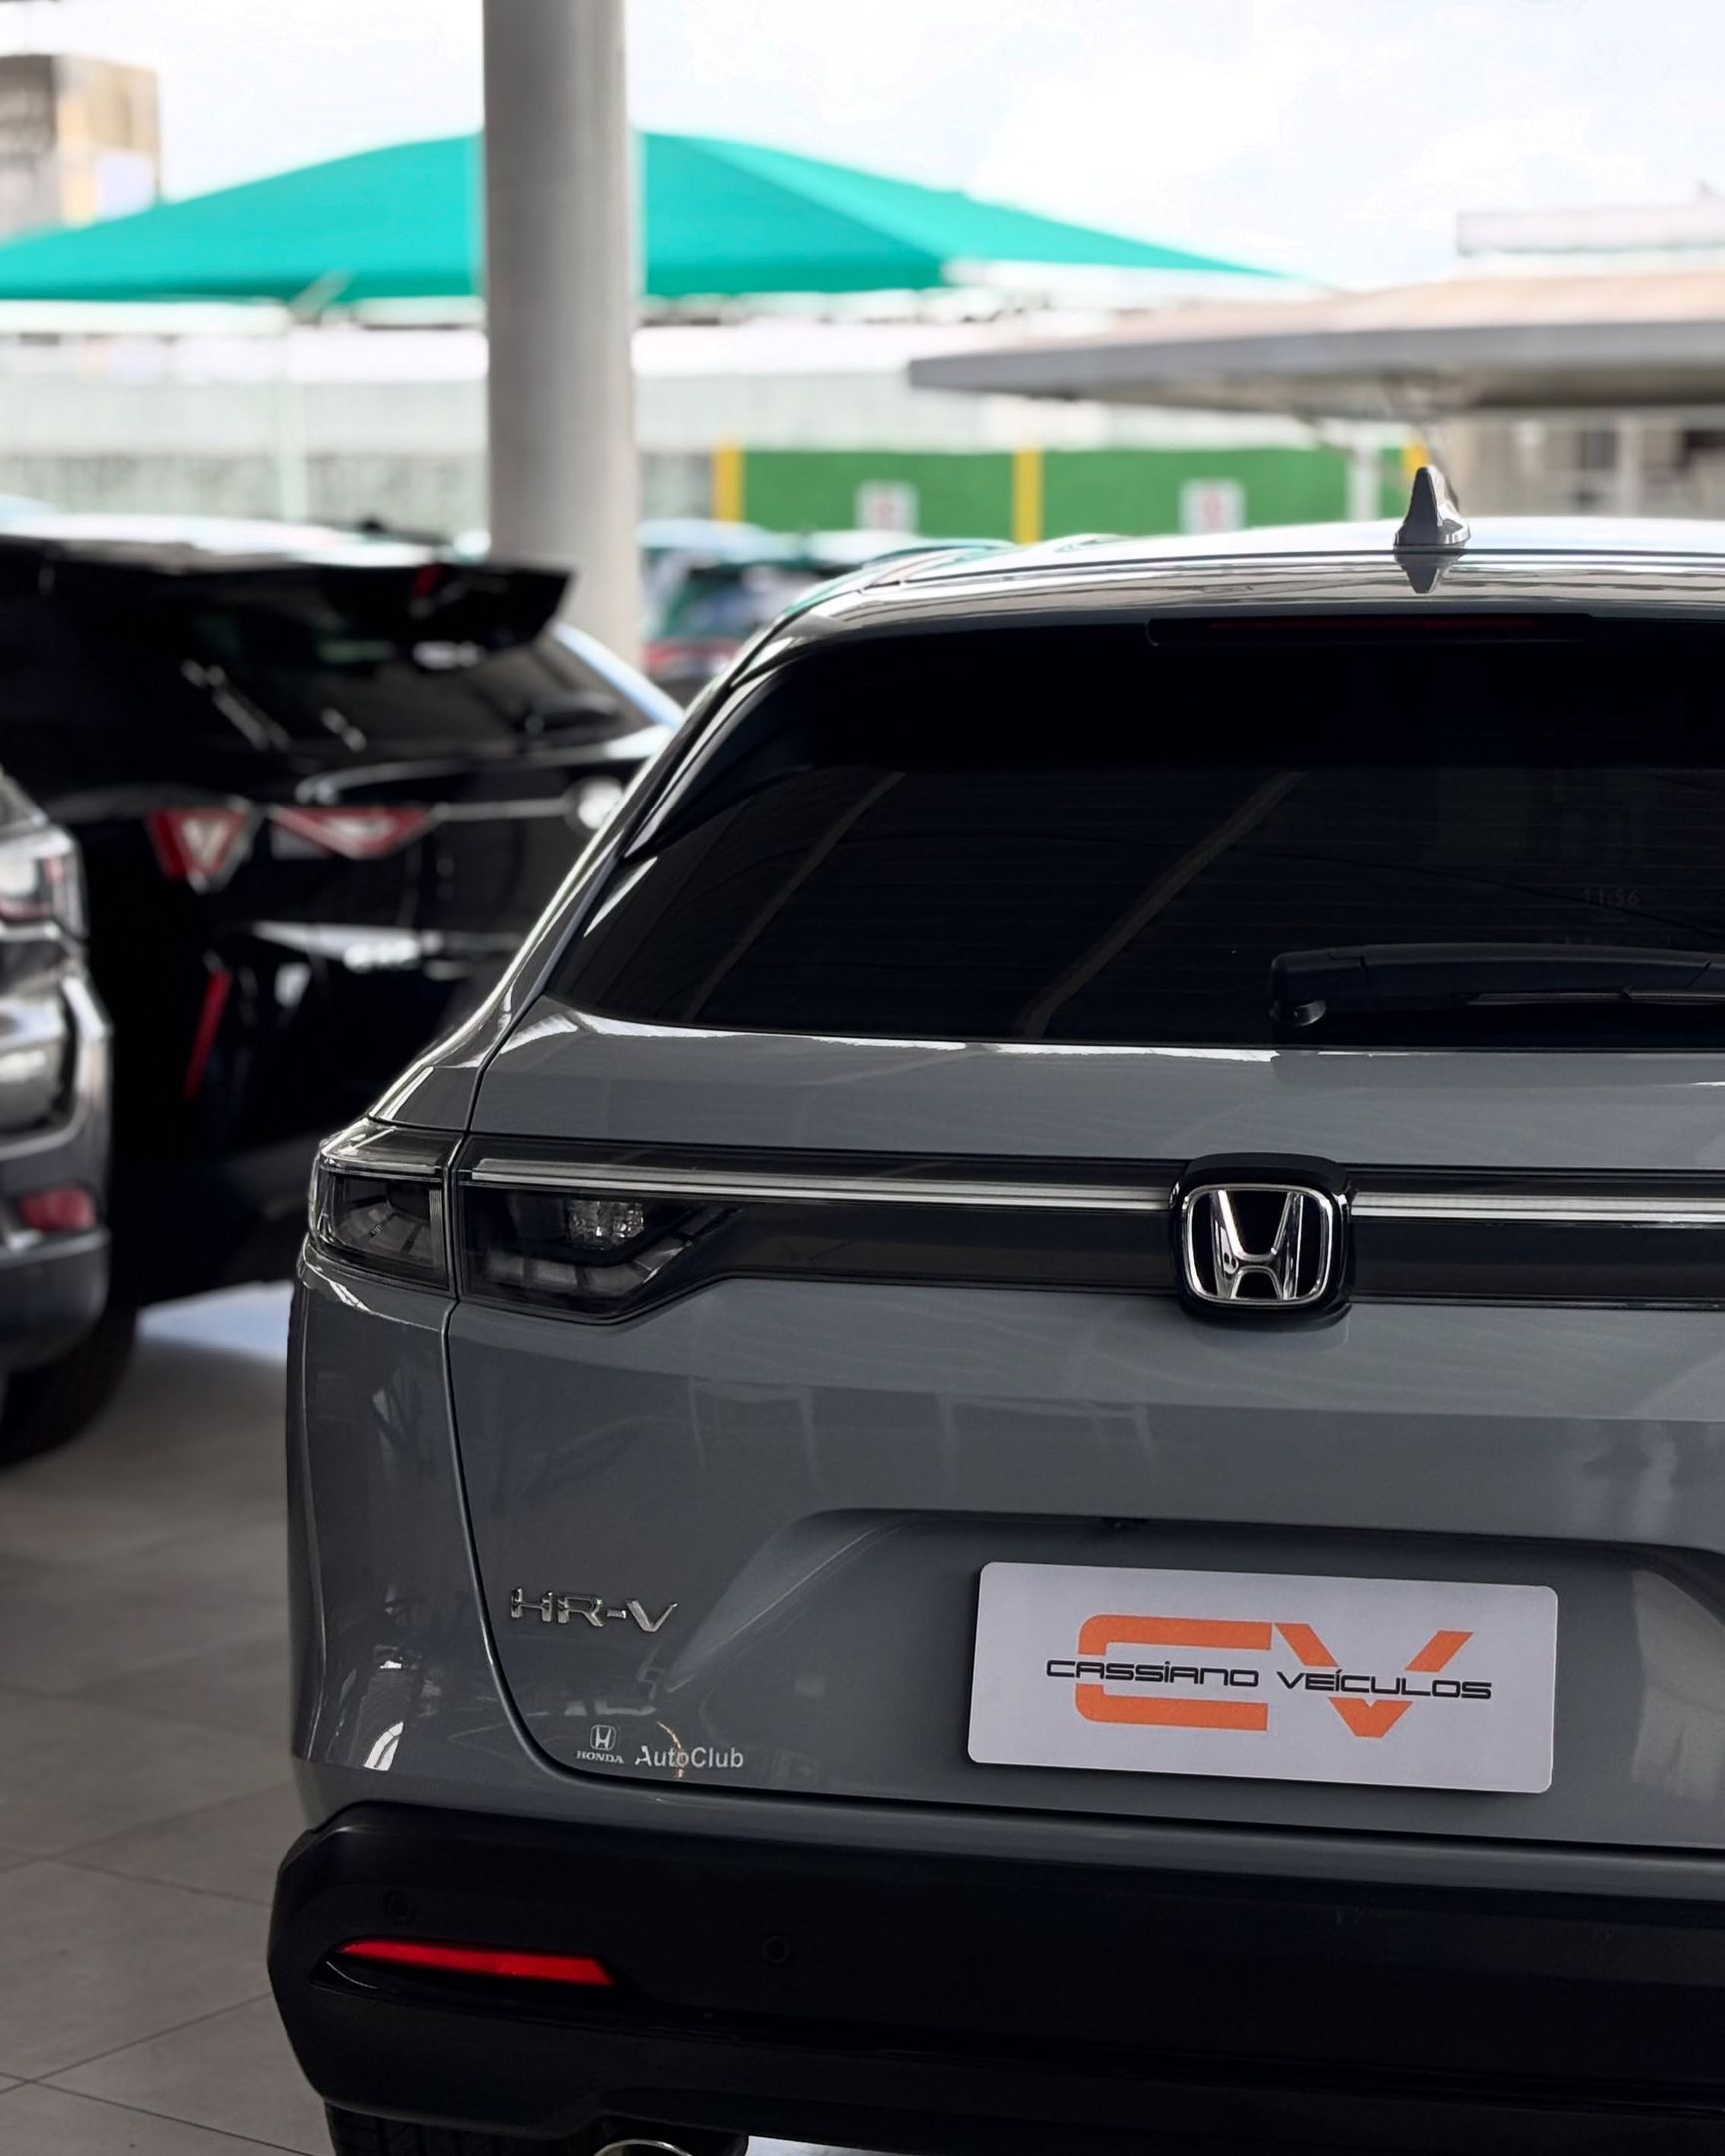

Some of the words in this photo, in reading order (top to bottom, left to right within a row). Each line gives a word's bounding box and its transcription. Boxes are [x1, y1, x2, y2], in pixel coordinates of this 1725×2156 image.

[510, 1588, 679, 1632] HR-V
[1276, 1669, 1493, 1699] VEÍCULOS
[576, 1749, 625, 1765] HONDA
[634, 1745, 745, 1769] AutoClub
